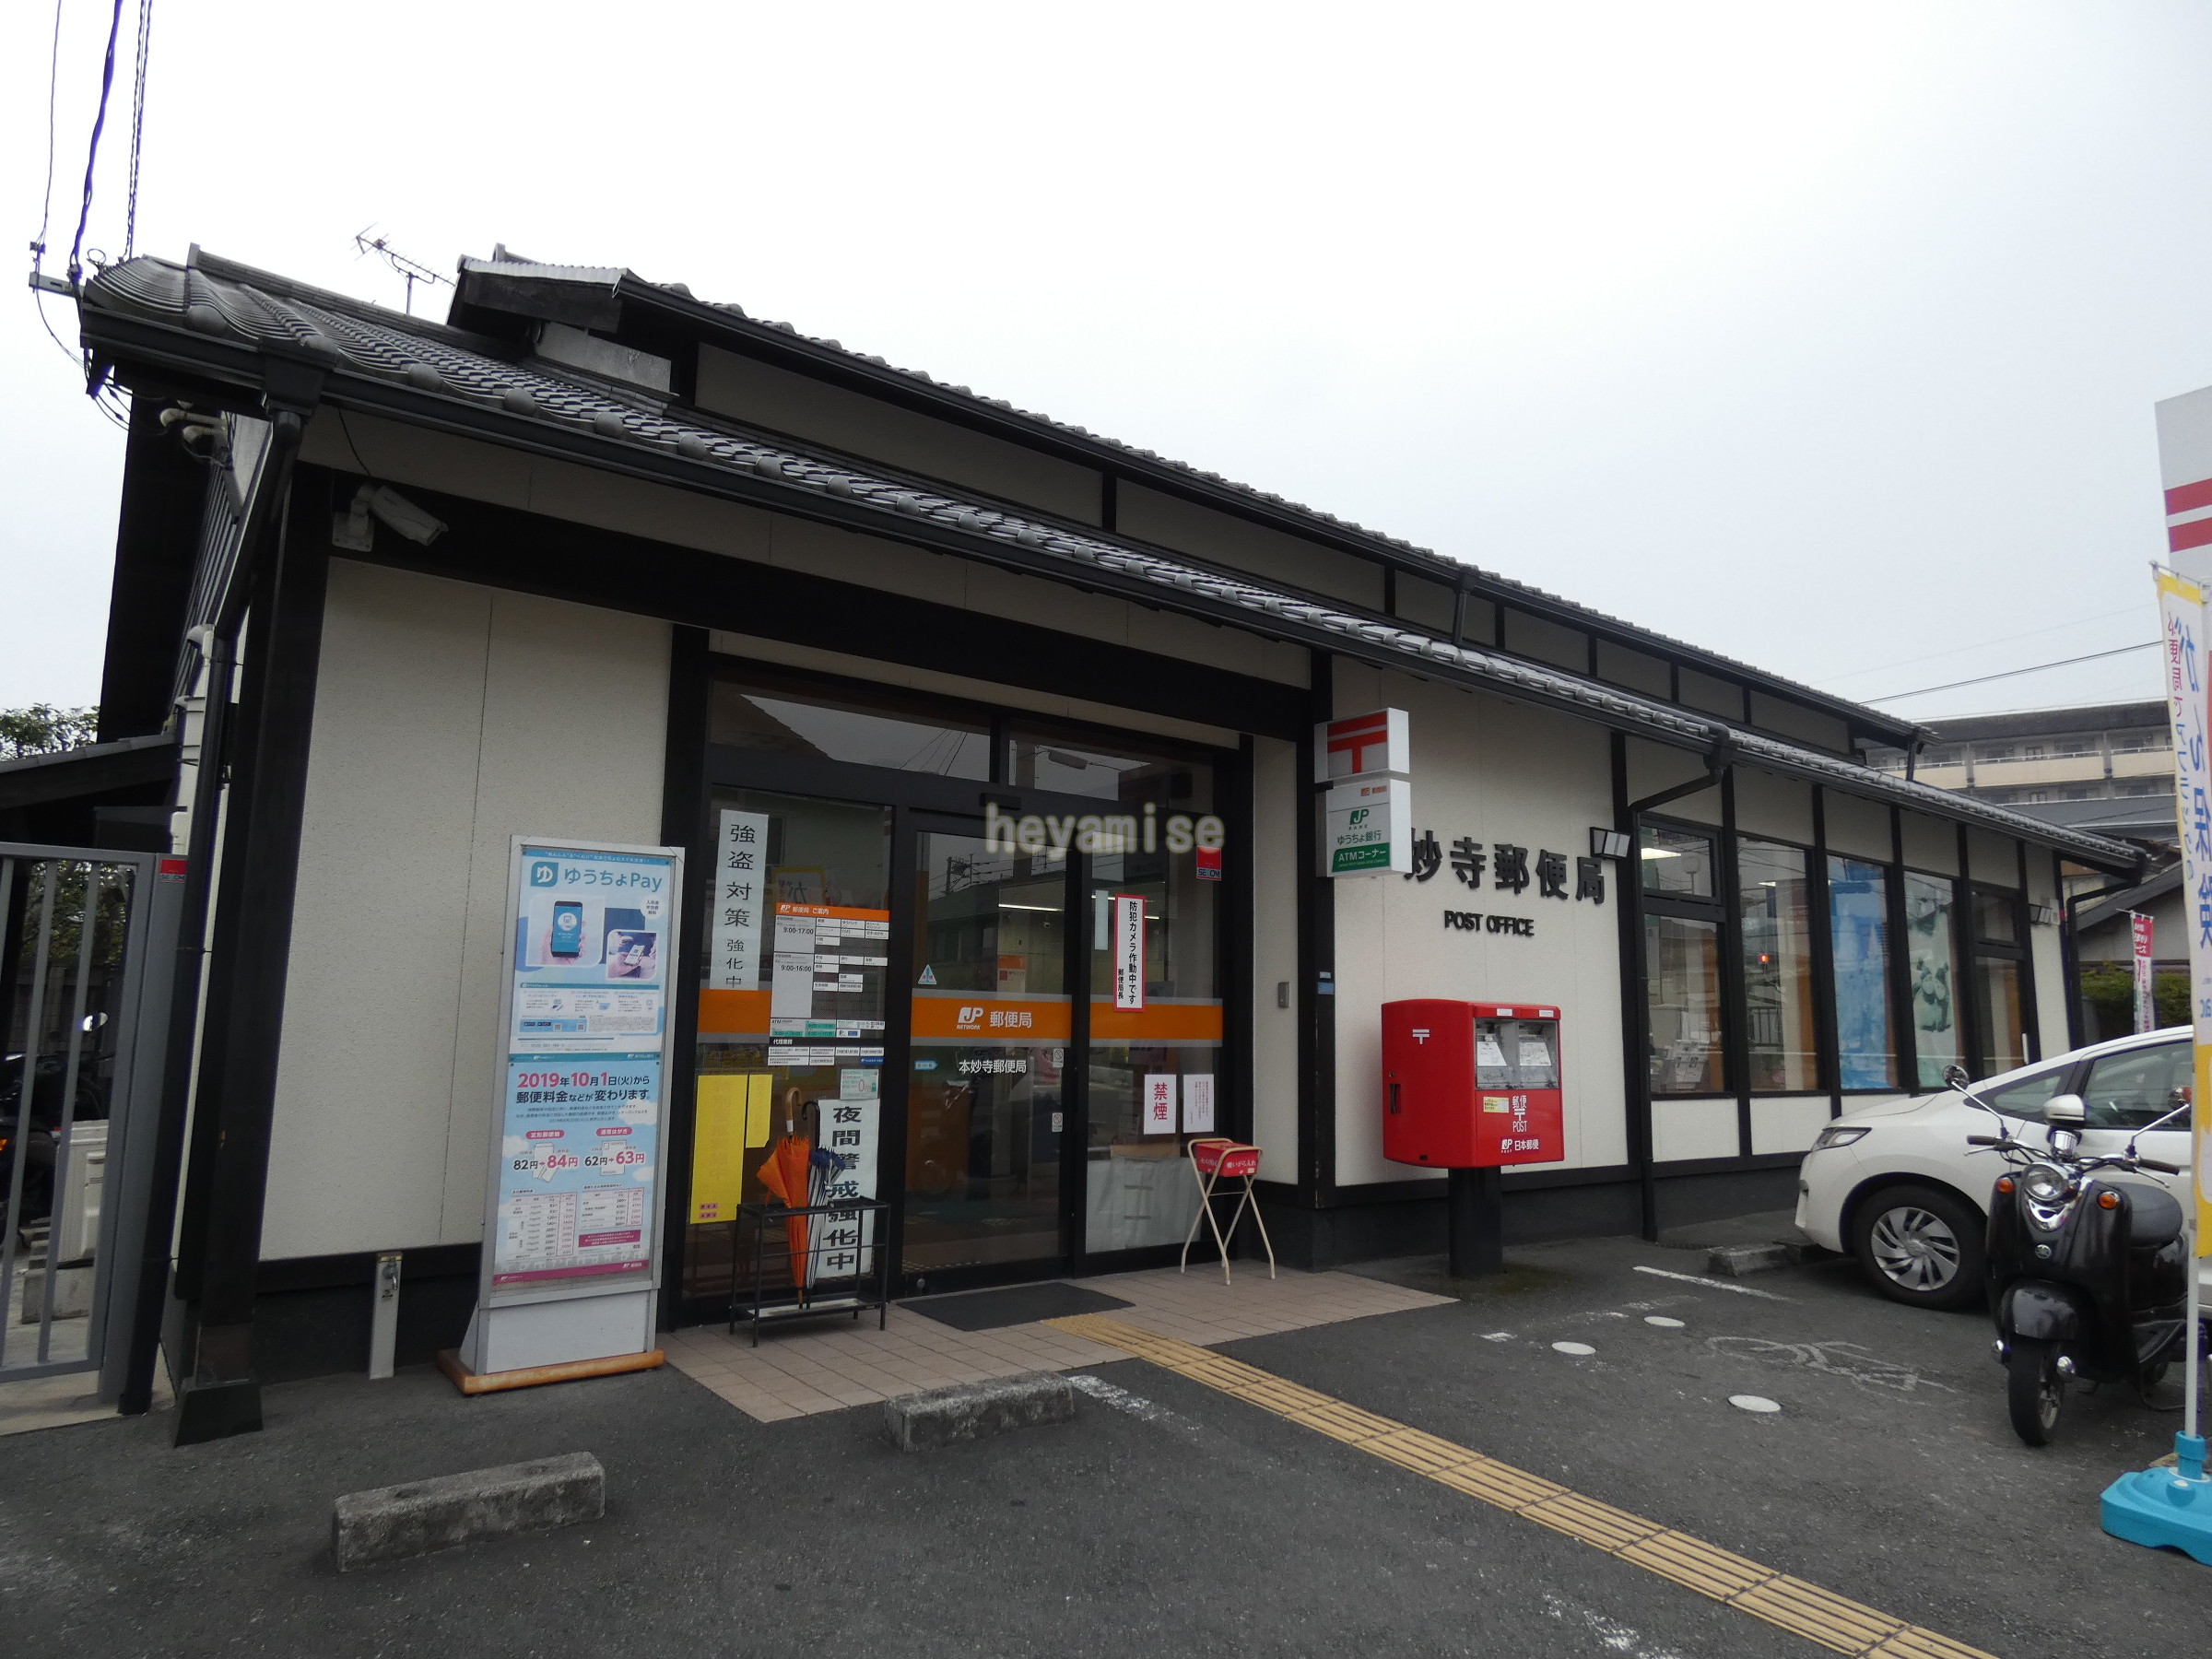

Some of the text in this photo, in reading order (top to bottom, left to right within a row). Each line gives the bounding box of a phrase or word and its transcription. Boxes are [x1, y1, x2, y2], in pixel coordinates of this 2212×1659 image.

[1337, 830, 1382, 845] ゆうちょ銀行
[1338, 848, 1386, 862] ATMコーナー
[564, 867, 663, 893] ゆうちょPay
[1443, 911, 1535, 937] POST OFFICE
[1128, 901, 1138, 1005] 防犯カメラ作動中です
[990, 1011, 1032, 1029] 郵便局
[959, 1059, 1027, 1074] 本妙寺郵便局
[517, 1071, 650, 1088] 2019年10月1日(火)から
[516, 1088, 650, 1104] 郵便料金などが変わります。
[1153, 1082, 1168, 1121] 禁煙
[1512, 1095, 1527, 1109] 郵便
[1512, 1121, 1527, 1132] POST
[1514, 1138, 1539, 1150] 日本郵便
[513, 1154, 578, 1170] 82円 84円
[584, 1151, 645, 1166] 62円 63円
